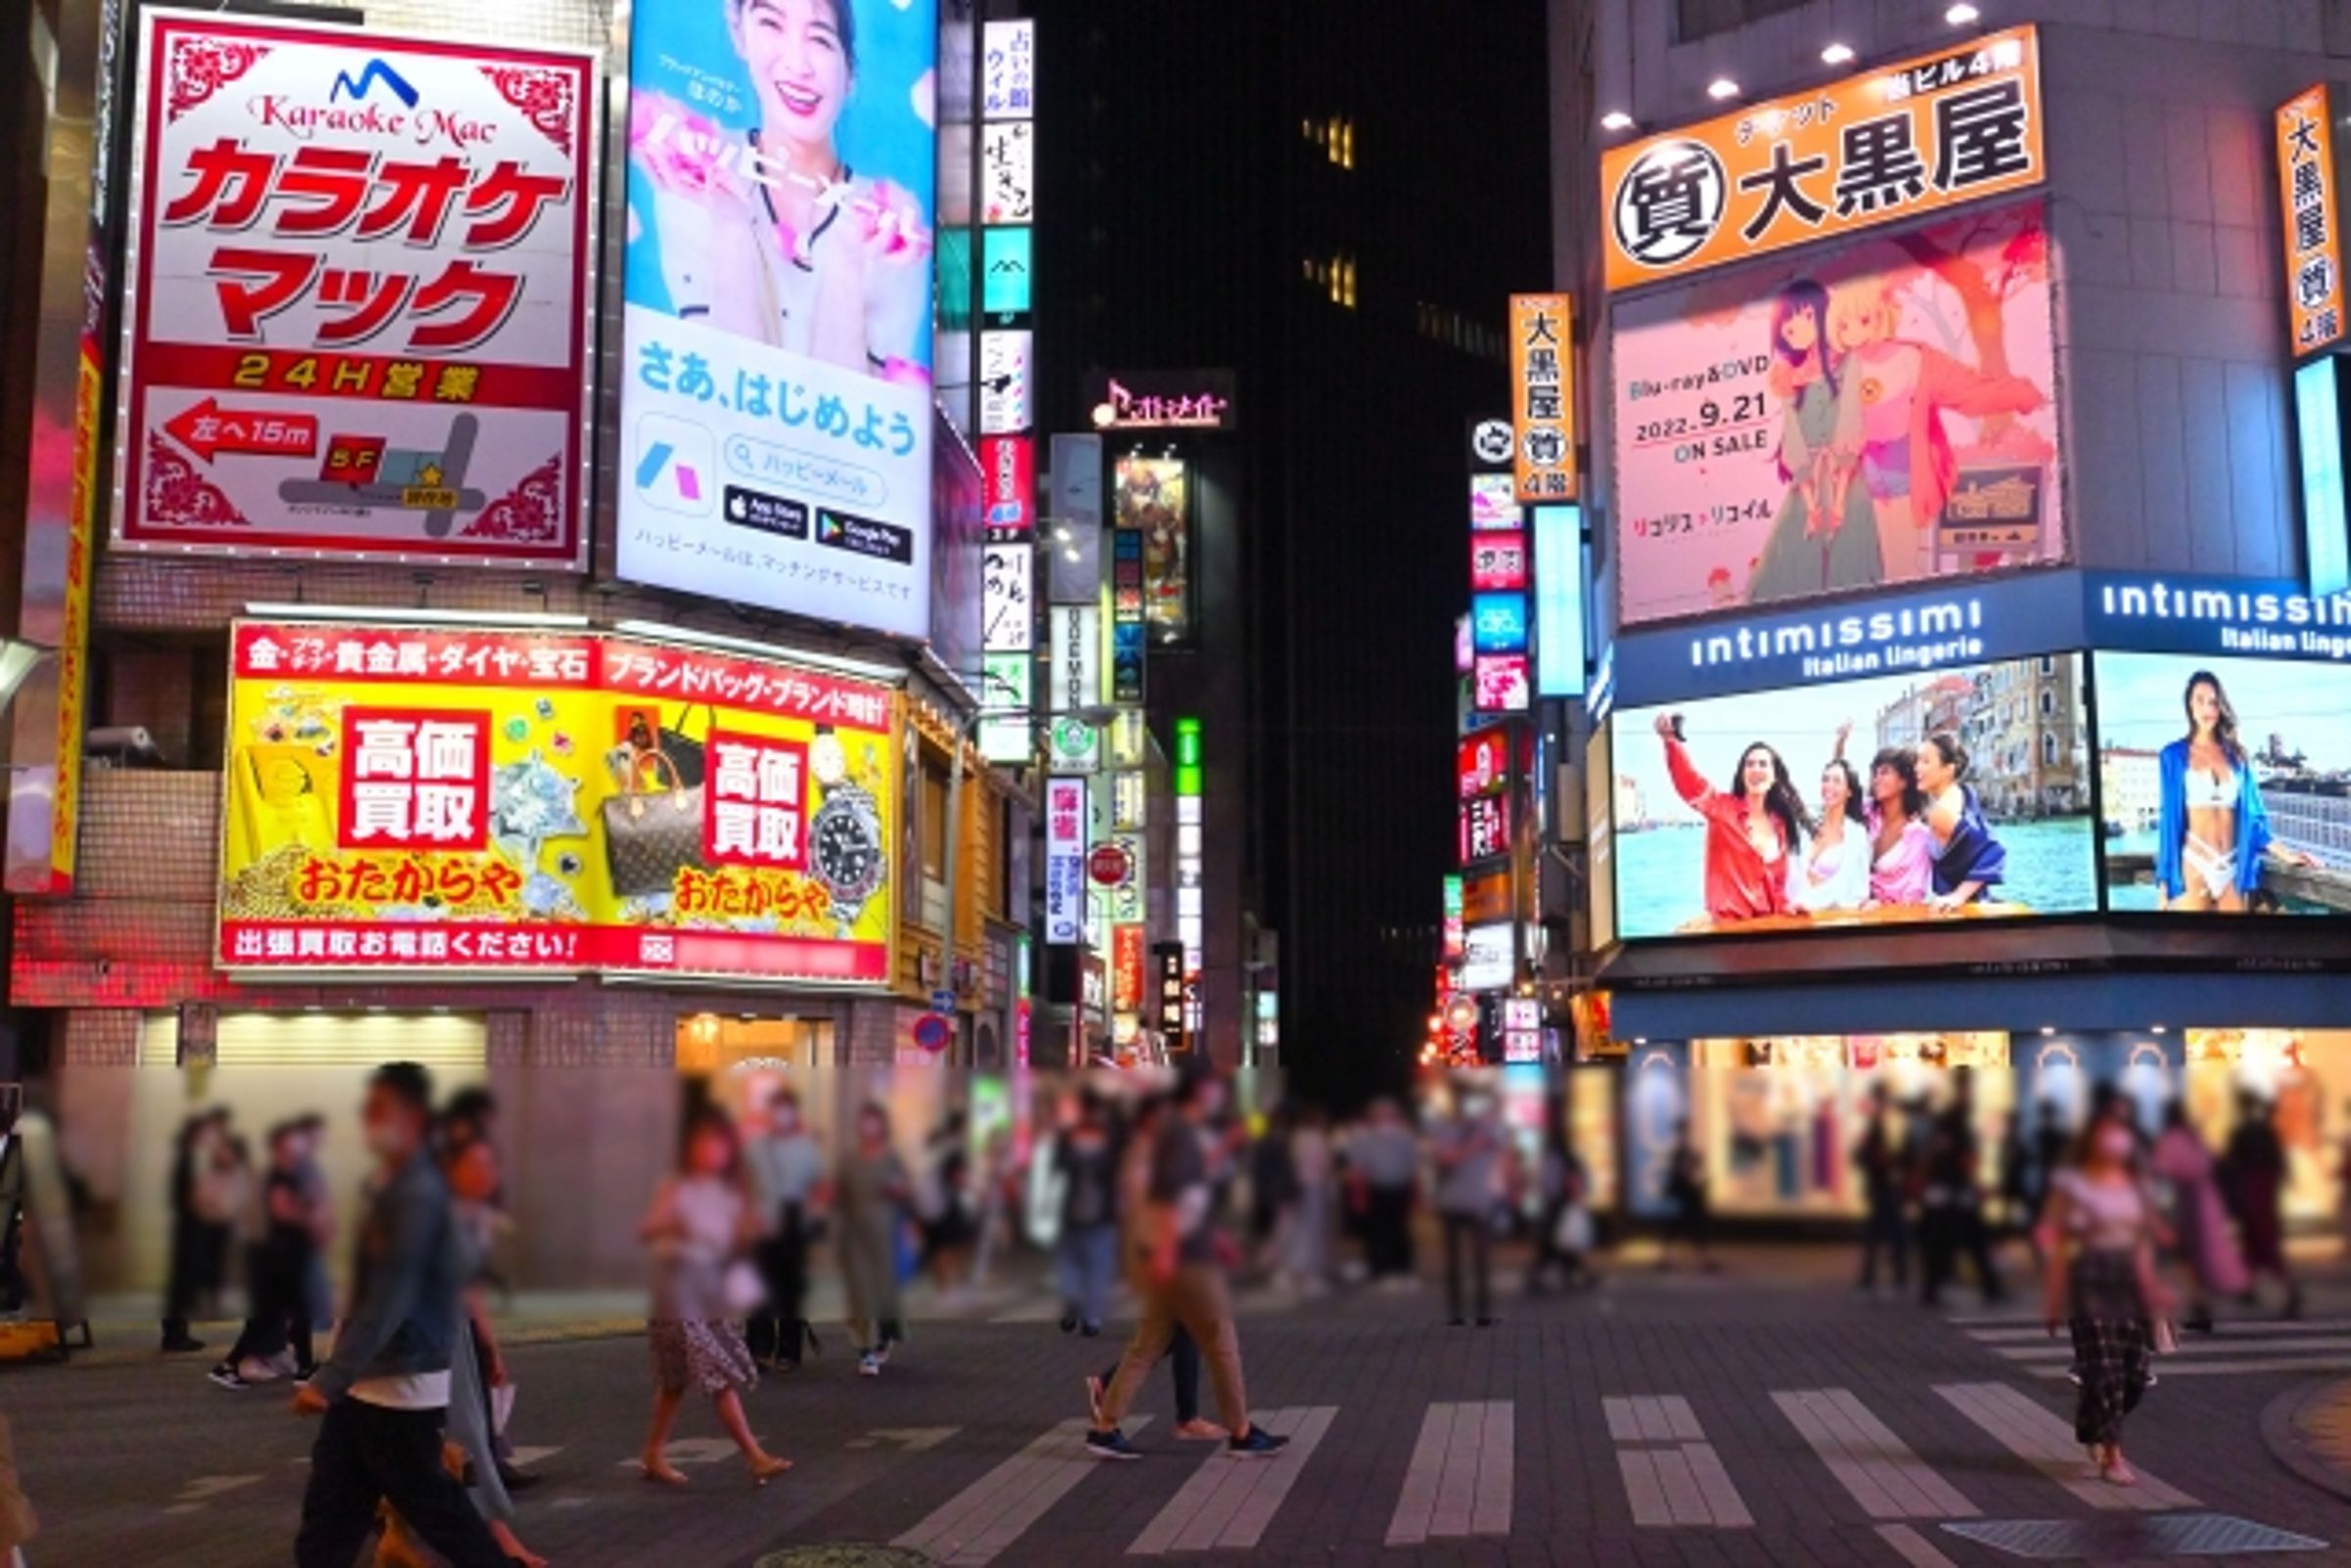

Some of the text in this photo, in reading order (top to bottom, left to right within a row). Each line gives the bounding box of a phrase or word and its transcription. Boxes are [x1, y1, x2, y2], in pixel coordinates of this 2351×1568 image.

[247, 94, 498, 148] Karaoke Mac
[1739, 76, 2033, 243] 大黒屋
[2288, 118, 2327, 251] 大黒屋
[161, 138, 571, 252] カラオケ
[1628, 152, 1717, 254] 質
[206, 247, 526, 354] マック
[234, 354, 479, 402] 24H営業
[1524, 311, 1562, 419] 大黒屋
[639, 340, 916, 457] さあ、はじめよう
[1674, 428, 1768, 463] ON SALE
[1691, 598, 1983, 667] intimissimi
[1803, 635, 1984, 678] Italian lingerie
[2222, 626, 2297, 651] Italian
[354, 720, 477, 781] 高価
[714, 742, 800, 805] 高価
[352, 782, 475, 841] 買取
[712, 801, 799, 860] 買取
[300, 857, 523, 905] おたからや
[676, 870, 831, 920] おたからや
[234, 929, 578, 959] 出張買取お電話ください!
